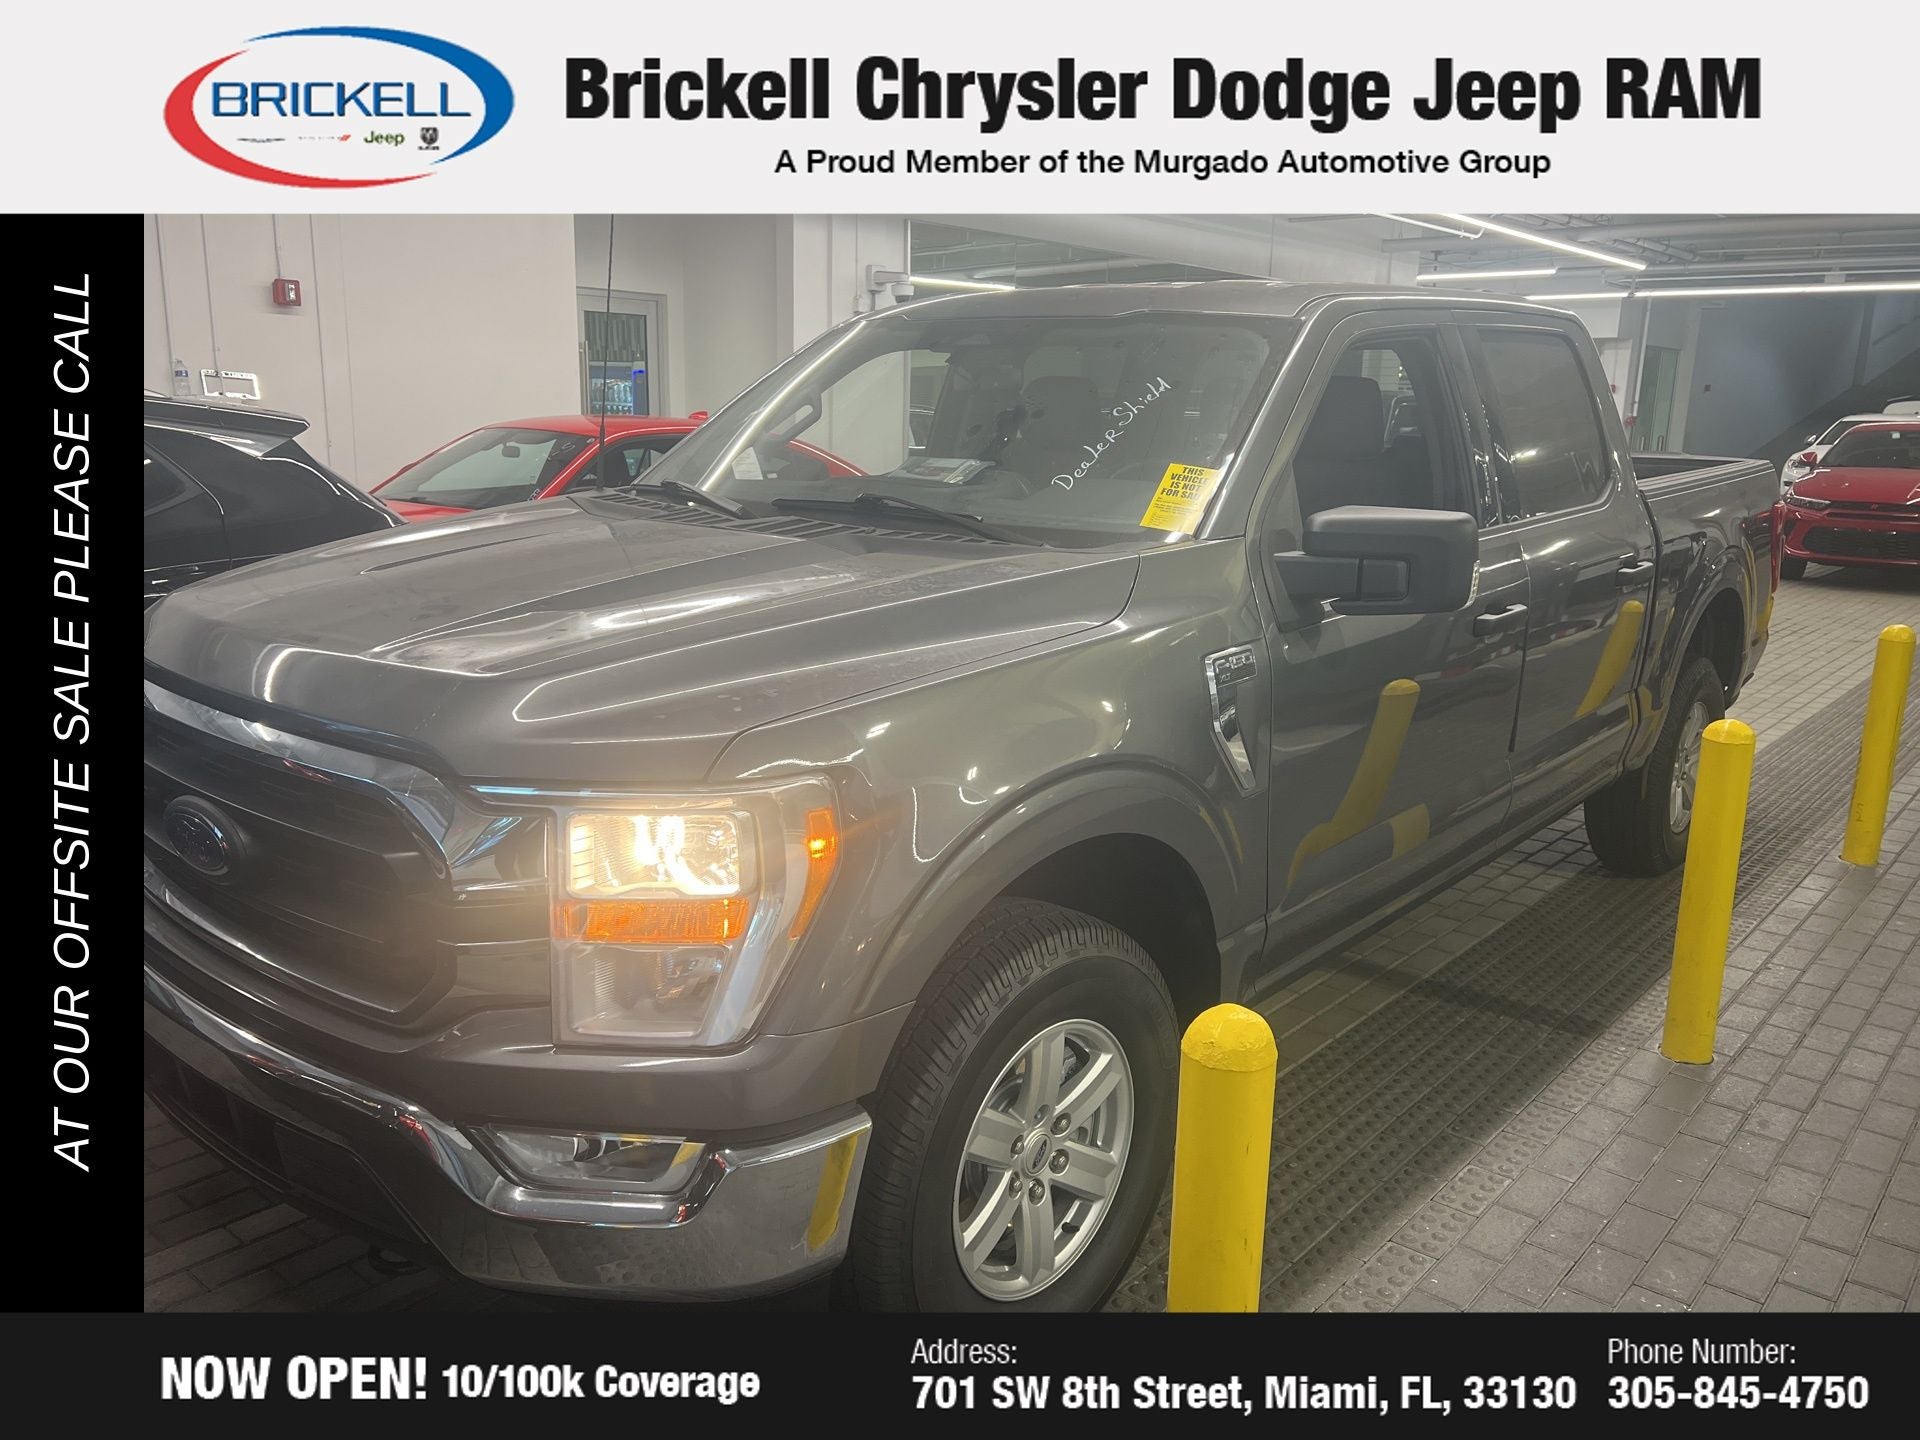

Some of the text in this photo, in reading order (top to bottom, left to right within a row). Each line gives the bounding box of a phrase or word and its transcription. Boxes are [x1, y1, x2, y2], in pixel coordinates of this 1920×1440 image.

[1182, 467, 1205, 477] THIS
[1170, 473, 1209, 485] VEHICLE
[1170, 481, 1202, 492] IS NOT
[1160, 487, 1180, 497] FOR
